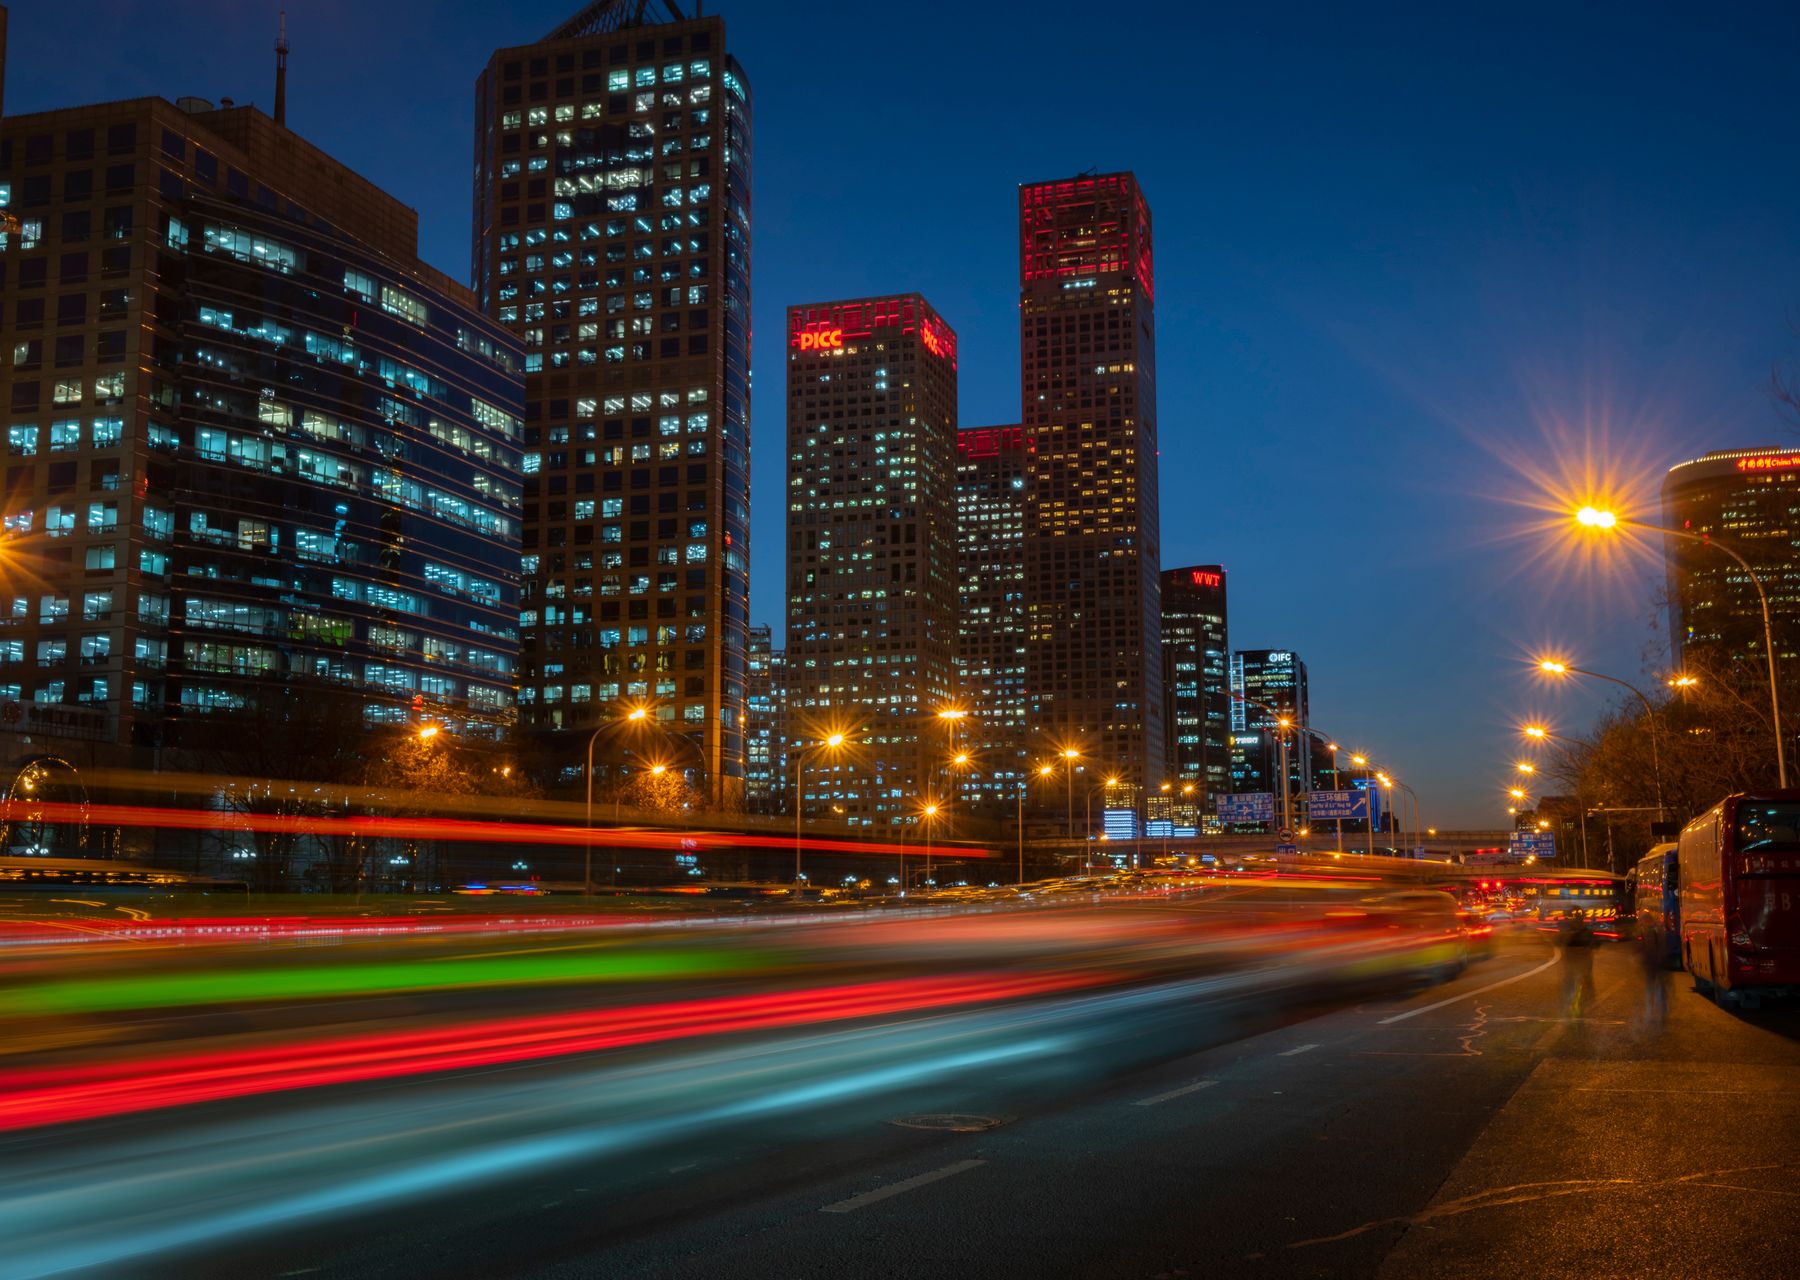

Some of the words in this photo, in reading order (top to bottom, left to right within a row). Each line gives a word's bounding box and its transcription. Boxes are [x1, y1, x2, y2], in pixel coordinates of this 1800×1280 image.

[800, 329, 842, 351] PICC
[1771, 457, 1791, 467] China
[1192, 571, 1220, 587] WWT
[1277, 653, 1291, 662] IFC
